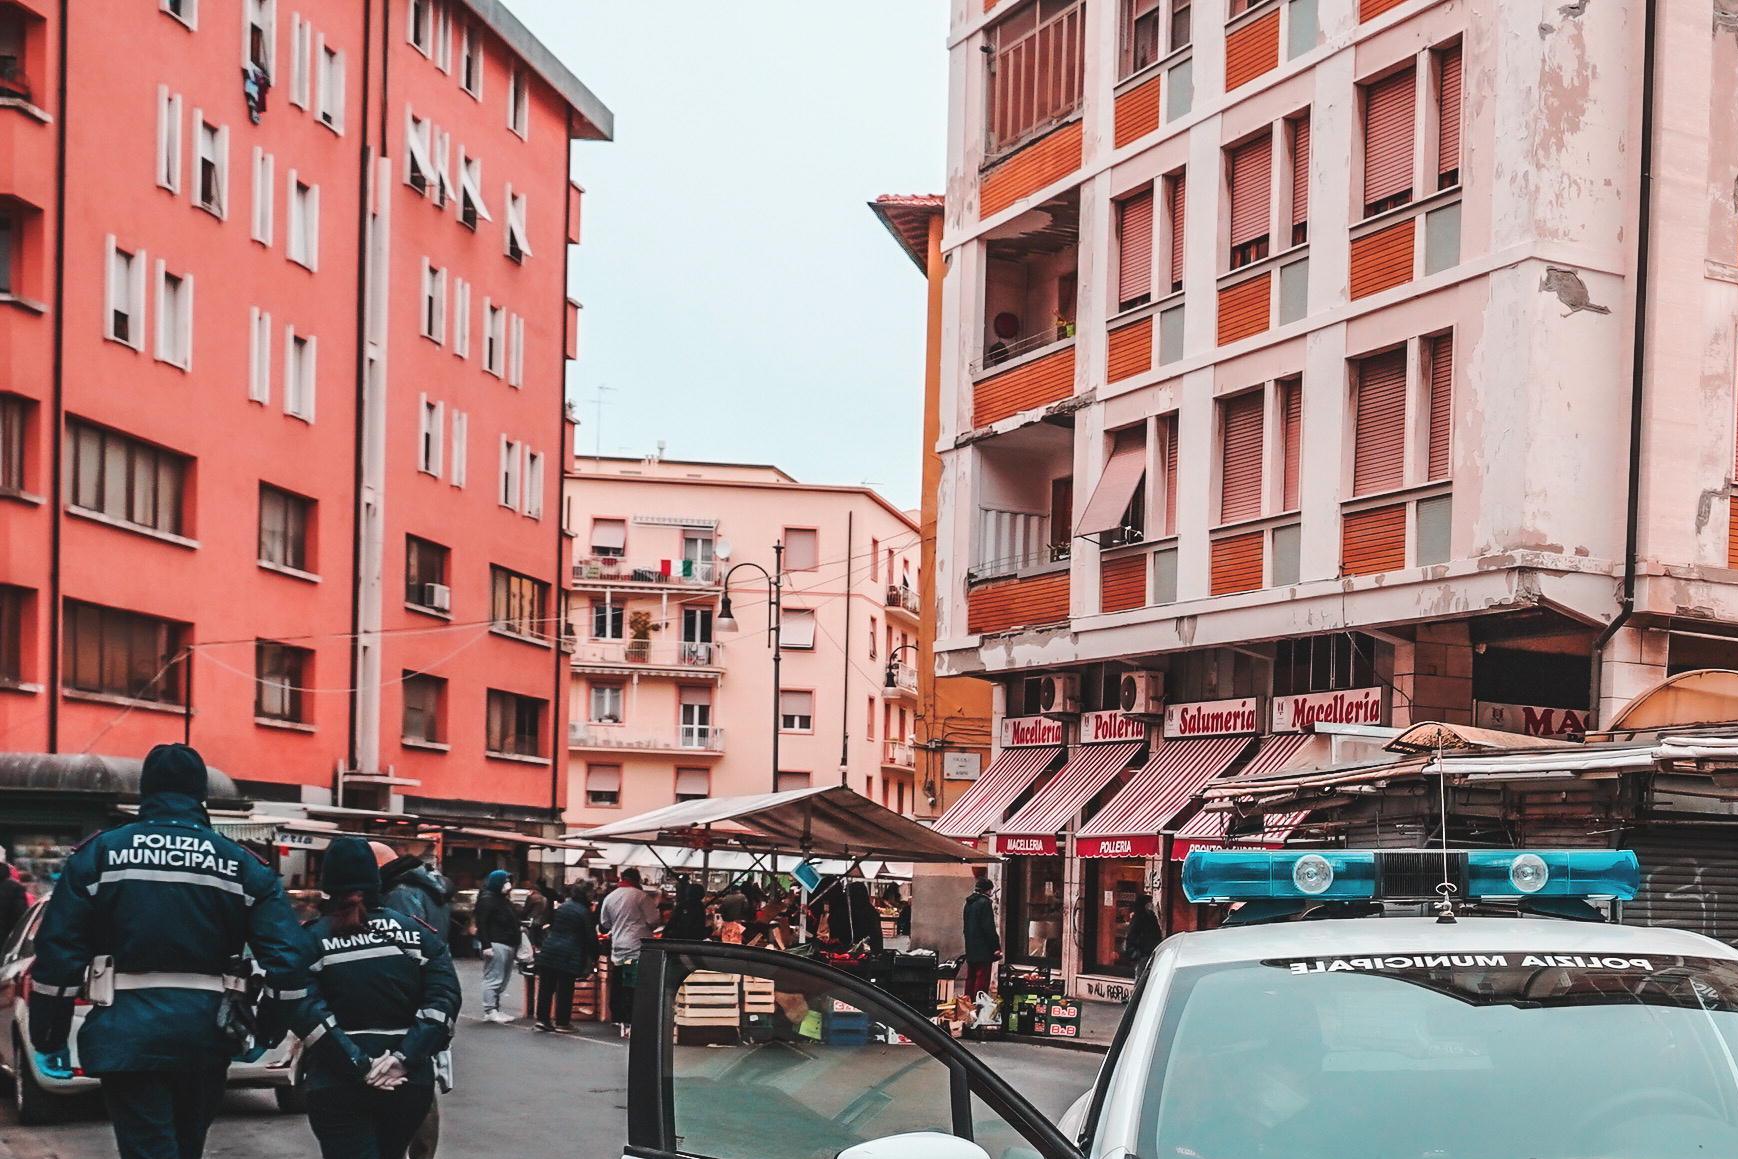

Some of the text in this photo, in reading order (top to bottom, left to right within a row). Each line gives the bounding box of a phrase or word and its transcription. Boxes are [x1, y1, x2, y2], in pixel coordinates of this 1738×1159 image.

[1179, 701, 1256, 734] Salumeria
[1292, 692, 1381, 728] Macelleria
[1522, 706, 1590, 736] MA
[1011, 717, 1063, 746] Macelleria
[1094, 712, 1145, 740] Polleria
[132, 834, 217, 855] POLIZIA
[1006, 838, 1044, 851] MACELLERIA
[1099, 840, 1132, 854] POLLERIA
[108, 848, 239, 877] MUNICIPALE
[321, 930, 421, 951] MUNICALE
